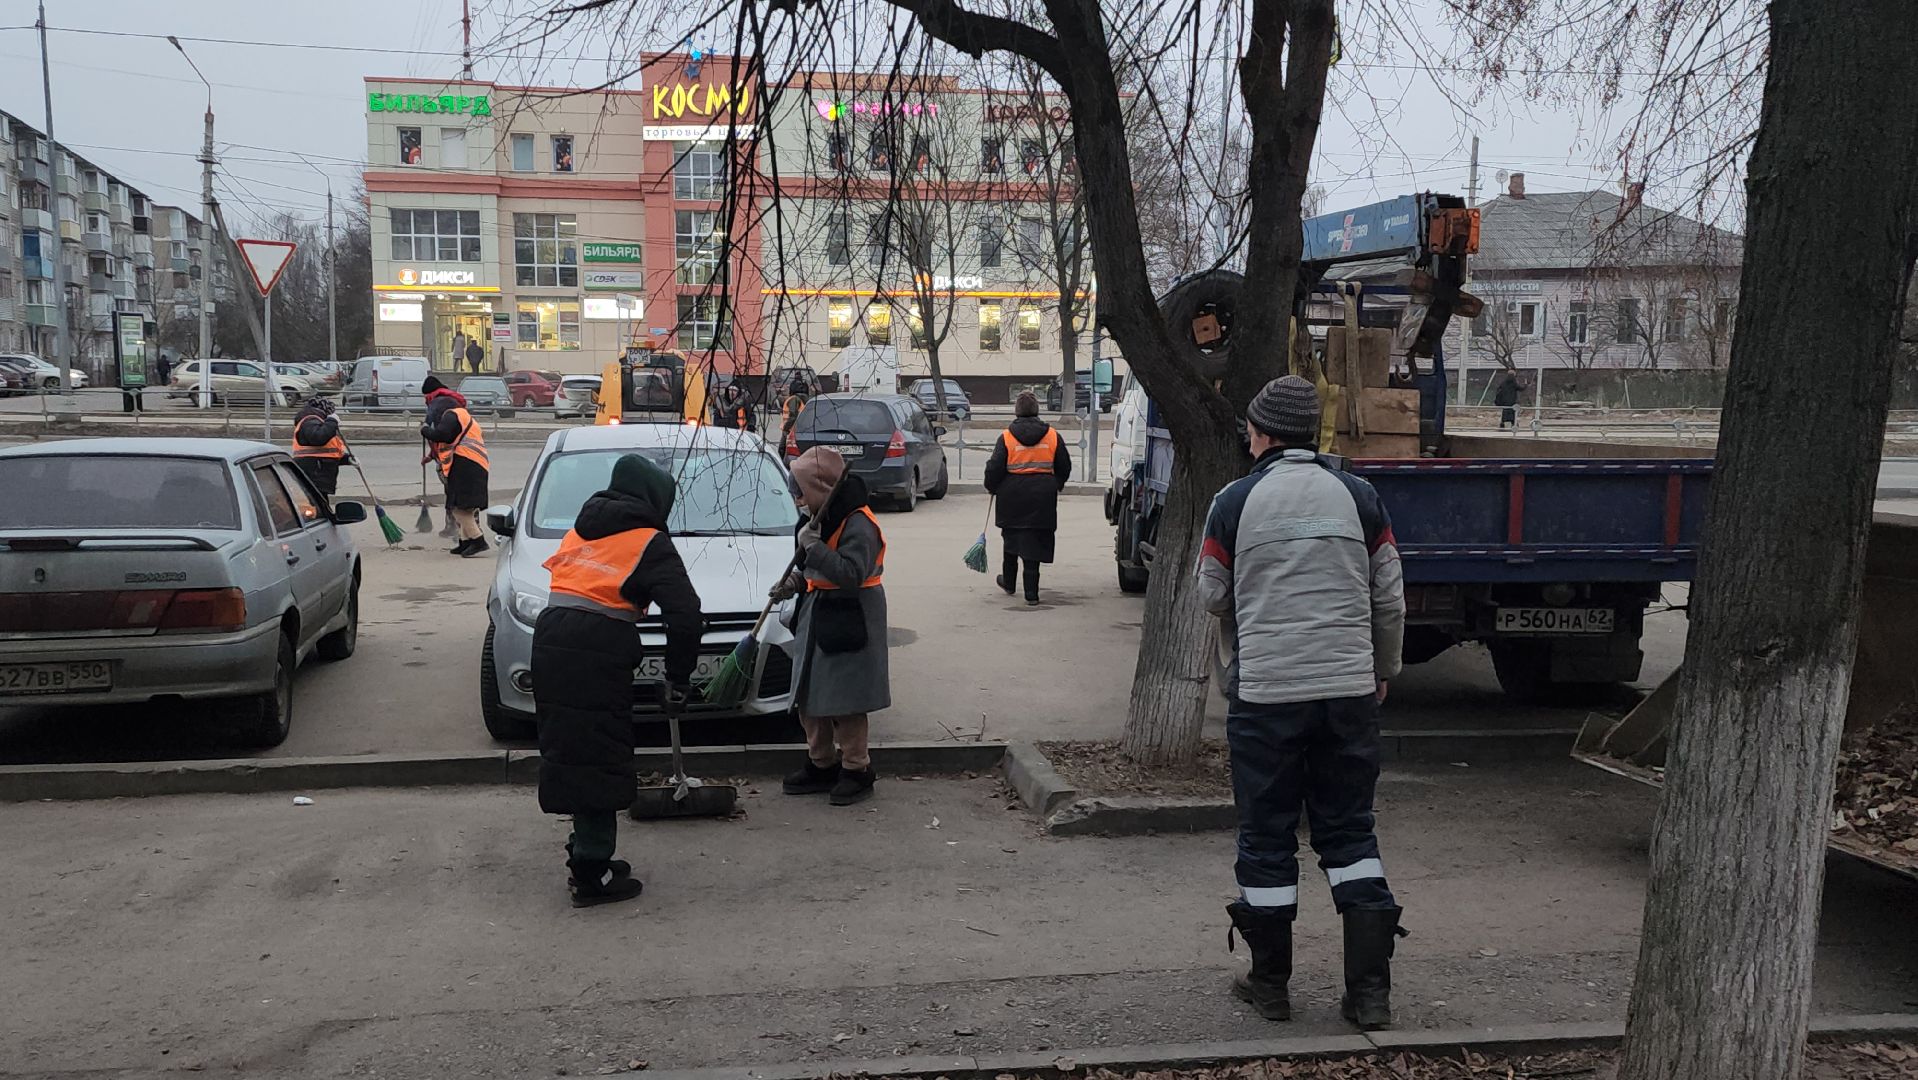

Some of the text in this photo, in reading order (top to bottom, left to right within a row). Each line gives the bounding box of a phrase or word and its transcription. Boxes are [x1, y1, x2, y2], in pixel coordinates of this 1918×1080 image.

[369, 93, 491, 116] БИЛЬЯРД
[653, 82, 749, 119] КОСМО
[583, 246, 641, 258] БИЛЬЯРД
[420, 270, 475, 285] ДИКСИ
[593, 275, 617, 283] CDEK
[933, 275, 983, 290] ДИКСИ
